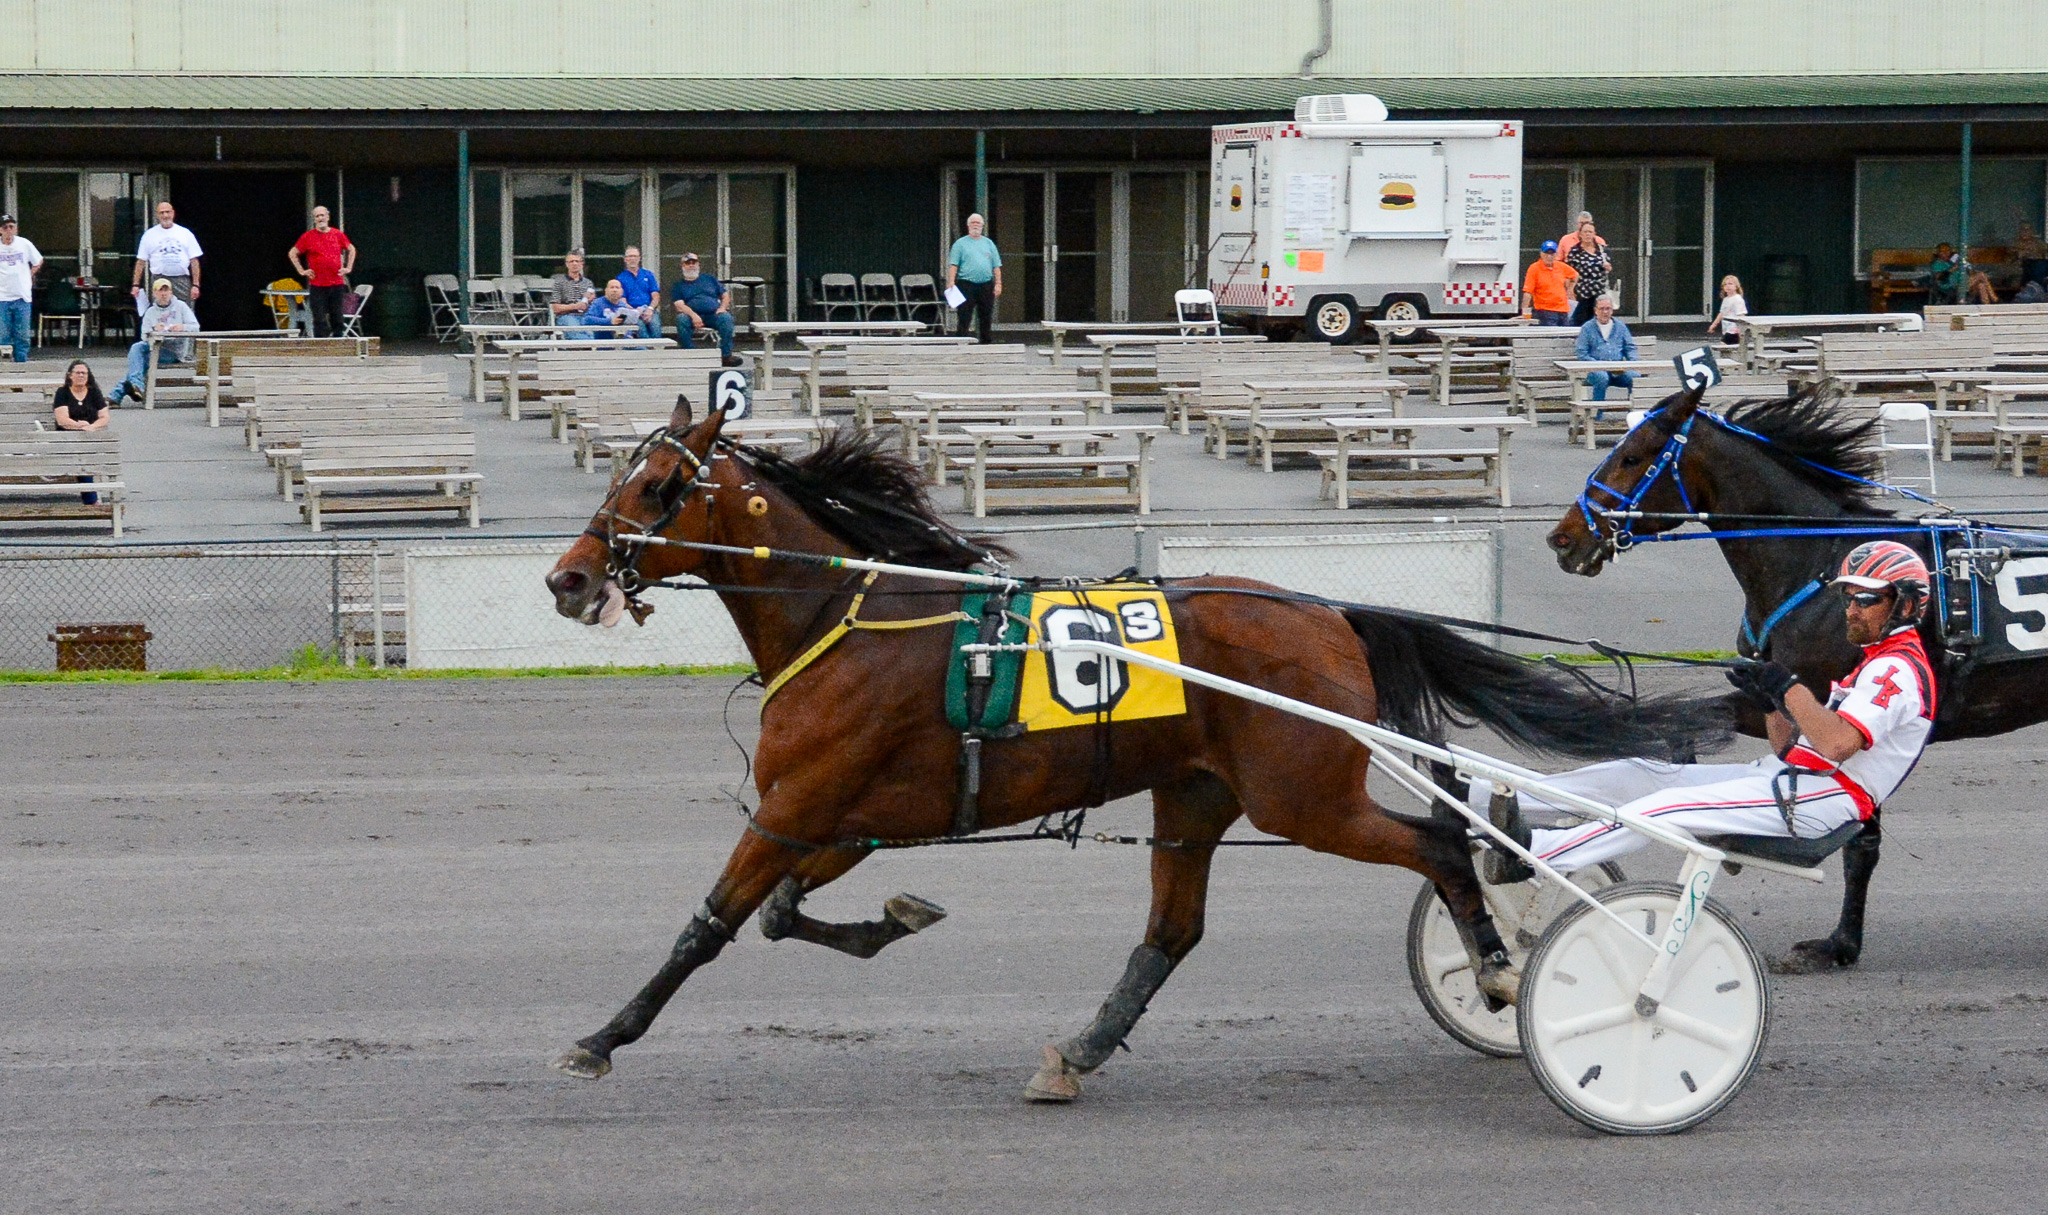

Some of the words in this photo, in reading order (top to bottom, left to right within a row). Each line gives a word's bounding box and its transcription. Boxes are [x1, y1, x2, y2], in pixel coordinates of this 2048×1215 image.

[1681, 347, 1714, 390] 5
[716, 370, 747, 420] 6
[1119, 600, 1163, 641] 3
[1995, 556, 2048, 652] 5
[1043, 606, 1126, 711] 6
